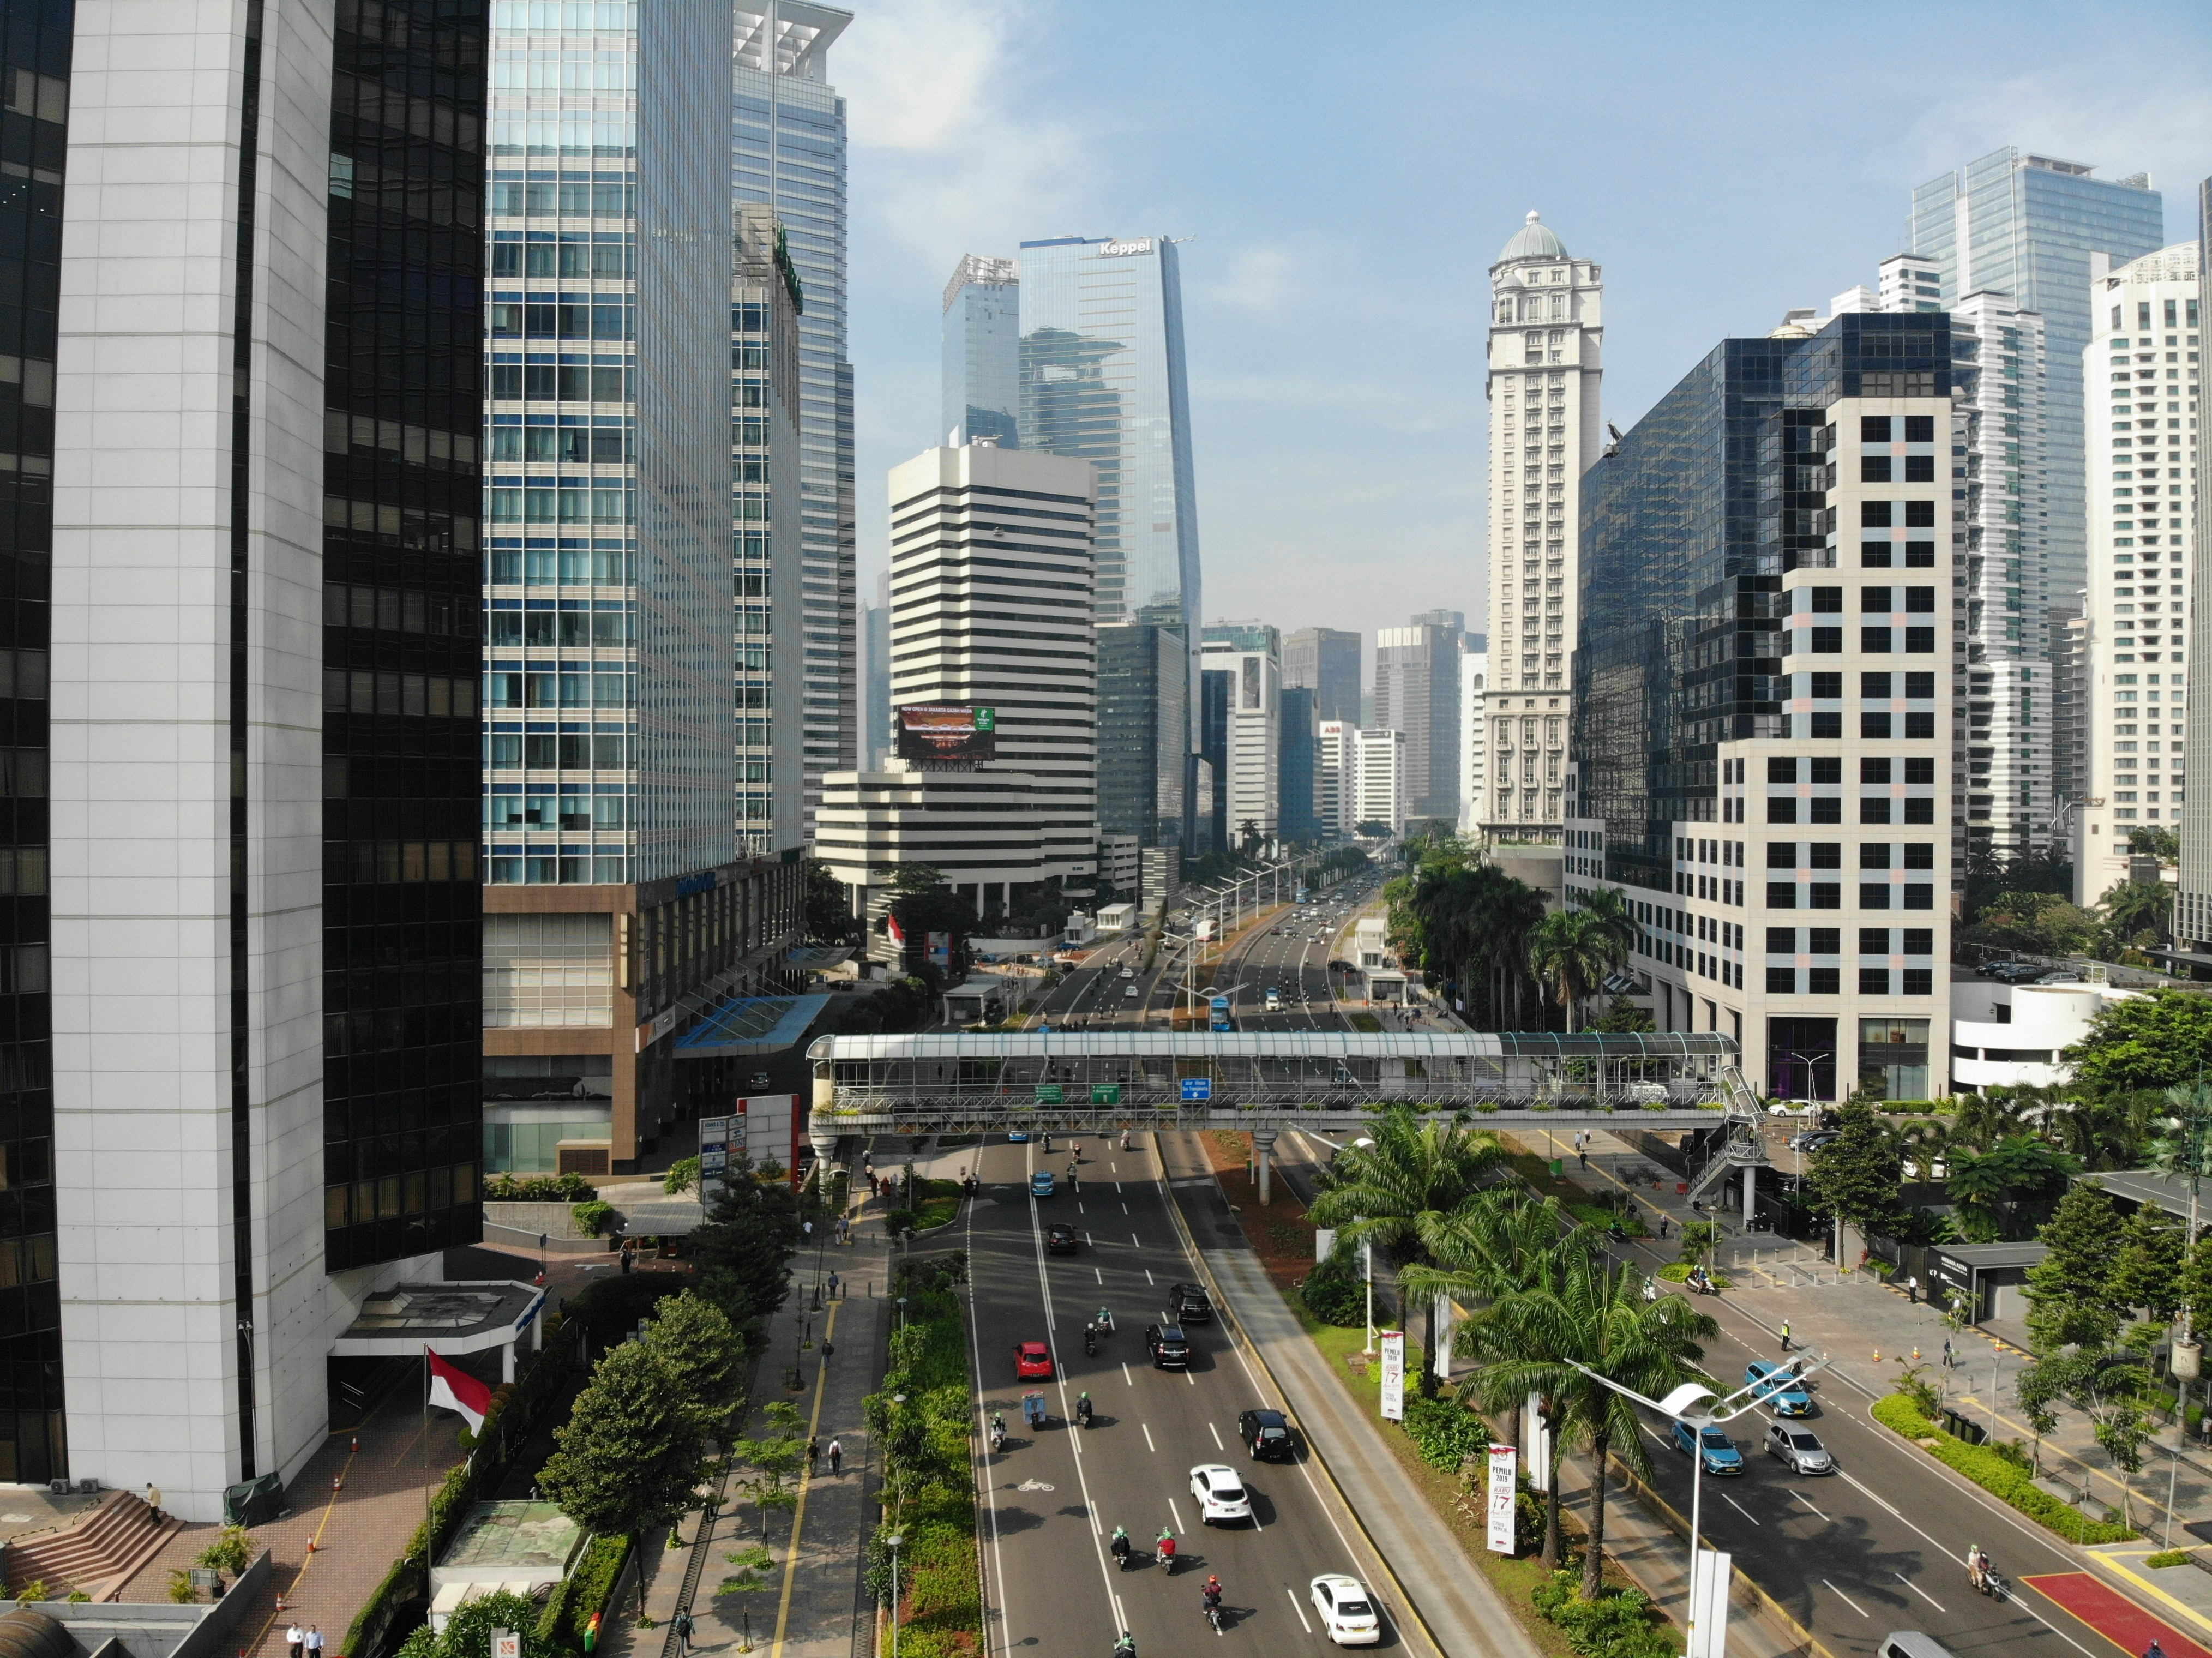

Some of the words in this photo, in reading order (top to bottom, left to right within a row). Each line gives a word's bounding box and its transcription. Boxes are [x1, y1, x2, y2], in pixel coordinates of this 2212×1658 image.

[1101, 239, 1150, 256] Keppel
[1385, 1348, 1400, 1356] PEMILU
[1386, 1371, 1400, 1384] 17
[1493, 1465, 1512, 1476] PEMILU
[1496, 1474, 1508, 1482] 2019
[1494, 1495, 1511, 1510] 17
